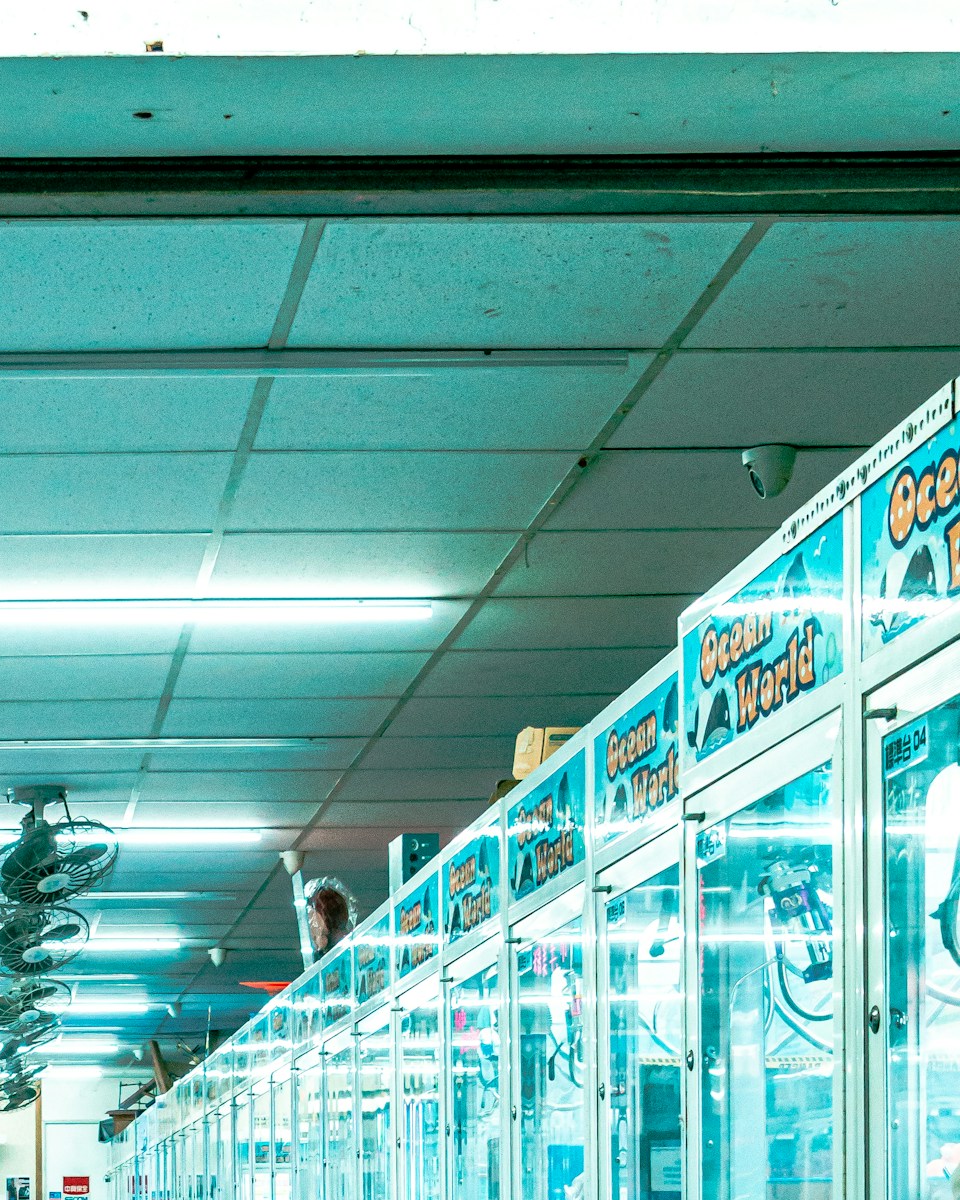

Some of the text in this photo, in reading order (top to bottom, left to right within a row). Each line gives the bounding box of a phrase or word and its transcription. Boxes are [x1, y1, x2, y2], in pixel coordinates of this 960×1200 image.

[889, 448, 960, 550] Oce
[700, 611, 773, 689] Ocean
[735, 616, 816, 734] World
[606, 709, 657, 783] Ocean
[913, 725, 926, 752] 04
[535, 820, 574, 888] World
